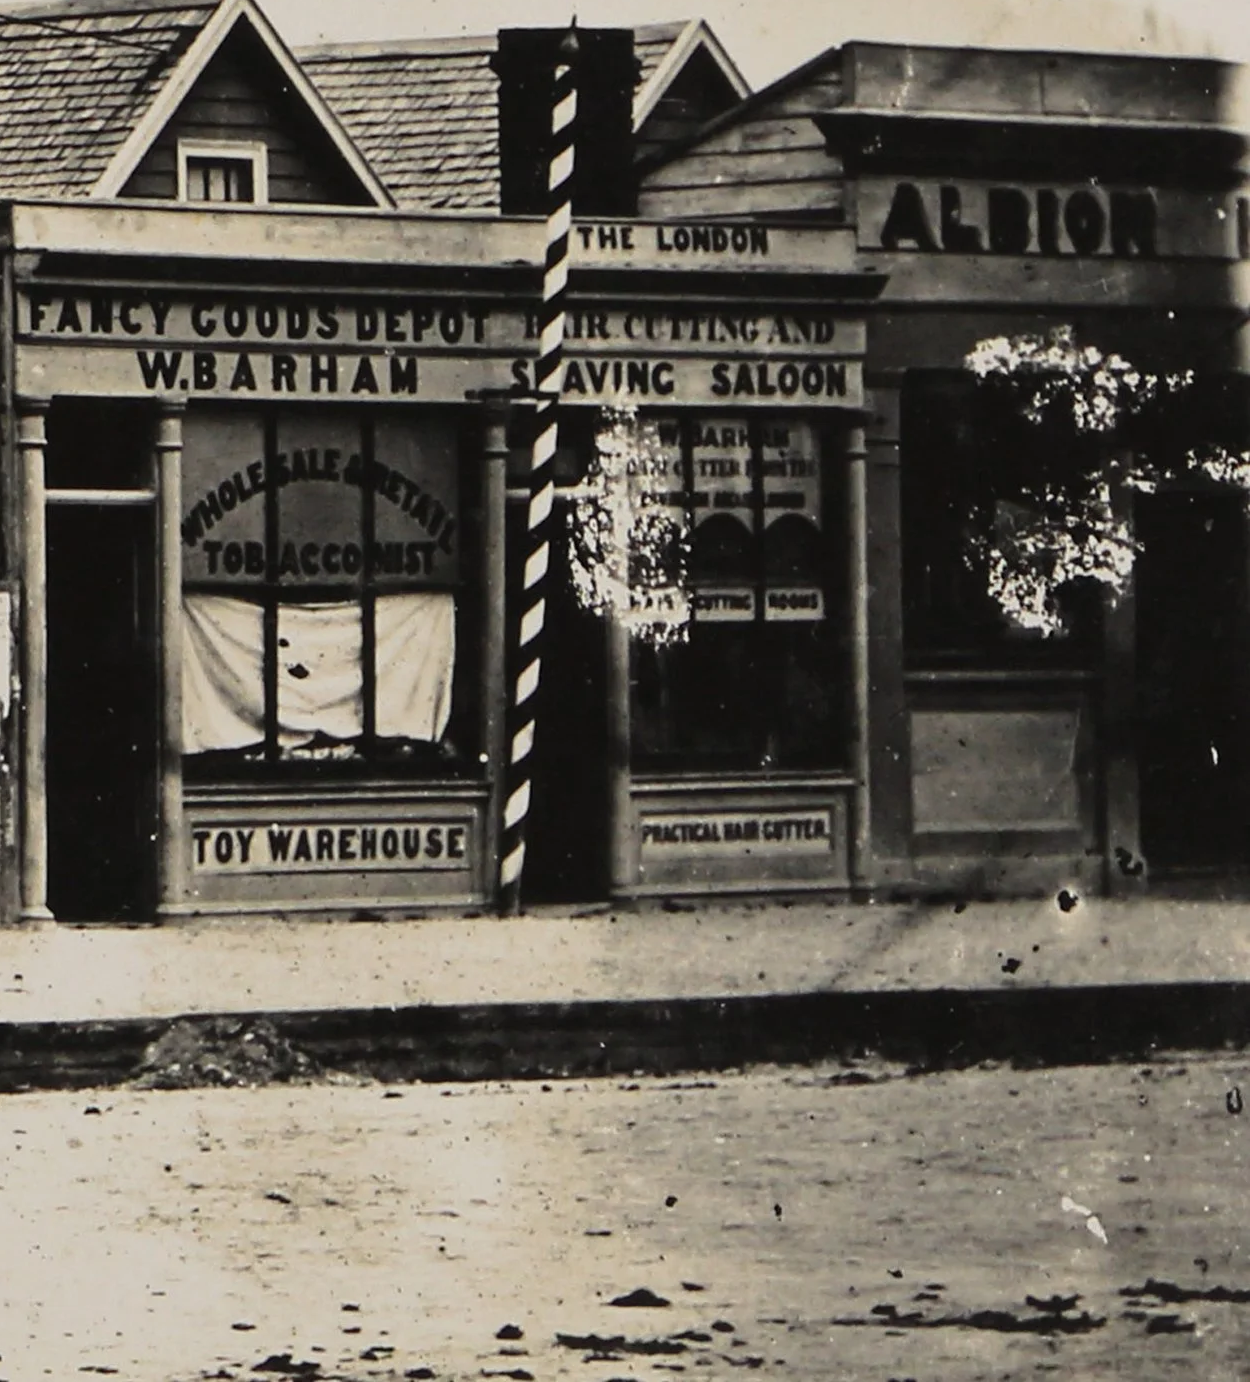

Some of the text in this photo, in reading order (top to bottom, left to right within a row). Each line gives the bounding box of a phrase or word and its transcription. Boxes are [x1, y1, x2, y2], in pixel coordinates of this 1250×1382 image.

[576, 226, 768, 255] THE LONDON
[29, 296, 488, 345] FANCY GOODS DEPOT
[624, 313, 759, 343] CUTTING
[767, 315, 834, 345] AND
[511, 360, 847, 397] SAVING SALOON
[202, 538, 438, 577] TOBACCONIST
[192, 826, 465, 864] TOY WAREHOUSE
[642, 822, 721, 843] PRACTICAL
[723, 820, 760, 842] HAIR
